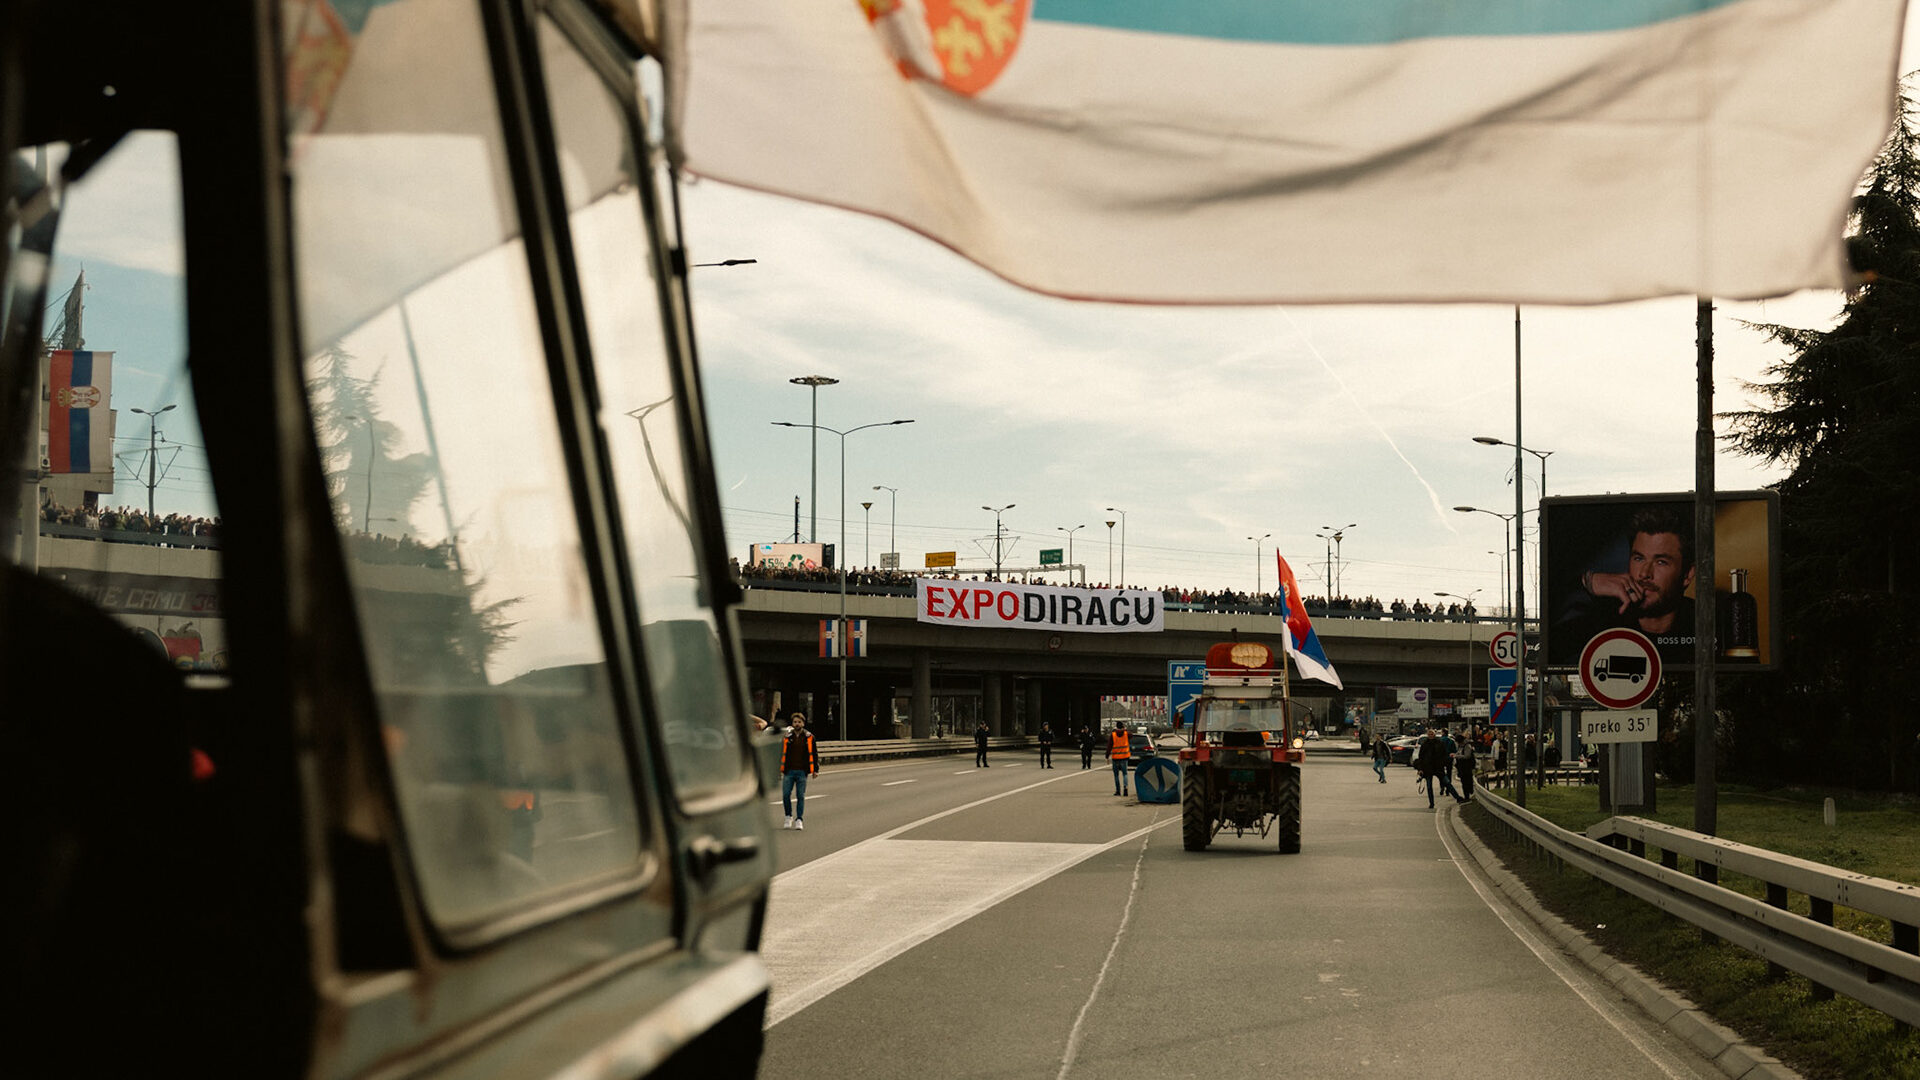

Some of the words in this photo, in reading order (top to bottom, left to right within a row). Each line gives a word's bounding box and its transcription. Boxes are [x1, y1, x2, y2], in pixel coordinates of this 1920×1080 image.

[926, 586, 1155, 626] EXPODIRAĆU
[1657, 637, 1679, 645] BOSS
[1588, 719, 1620, 737] preko
